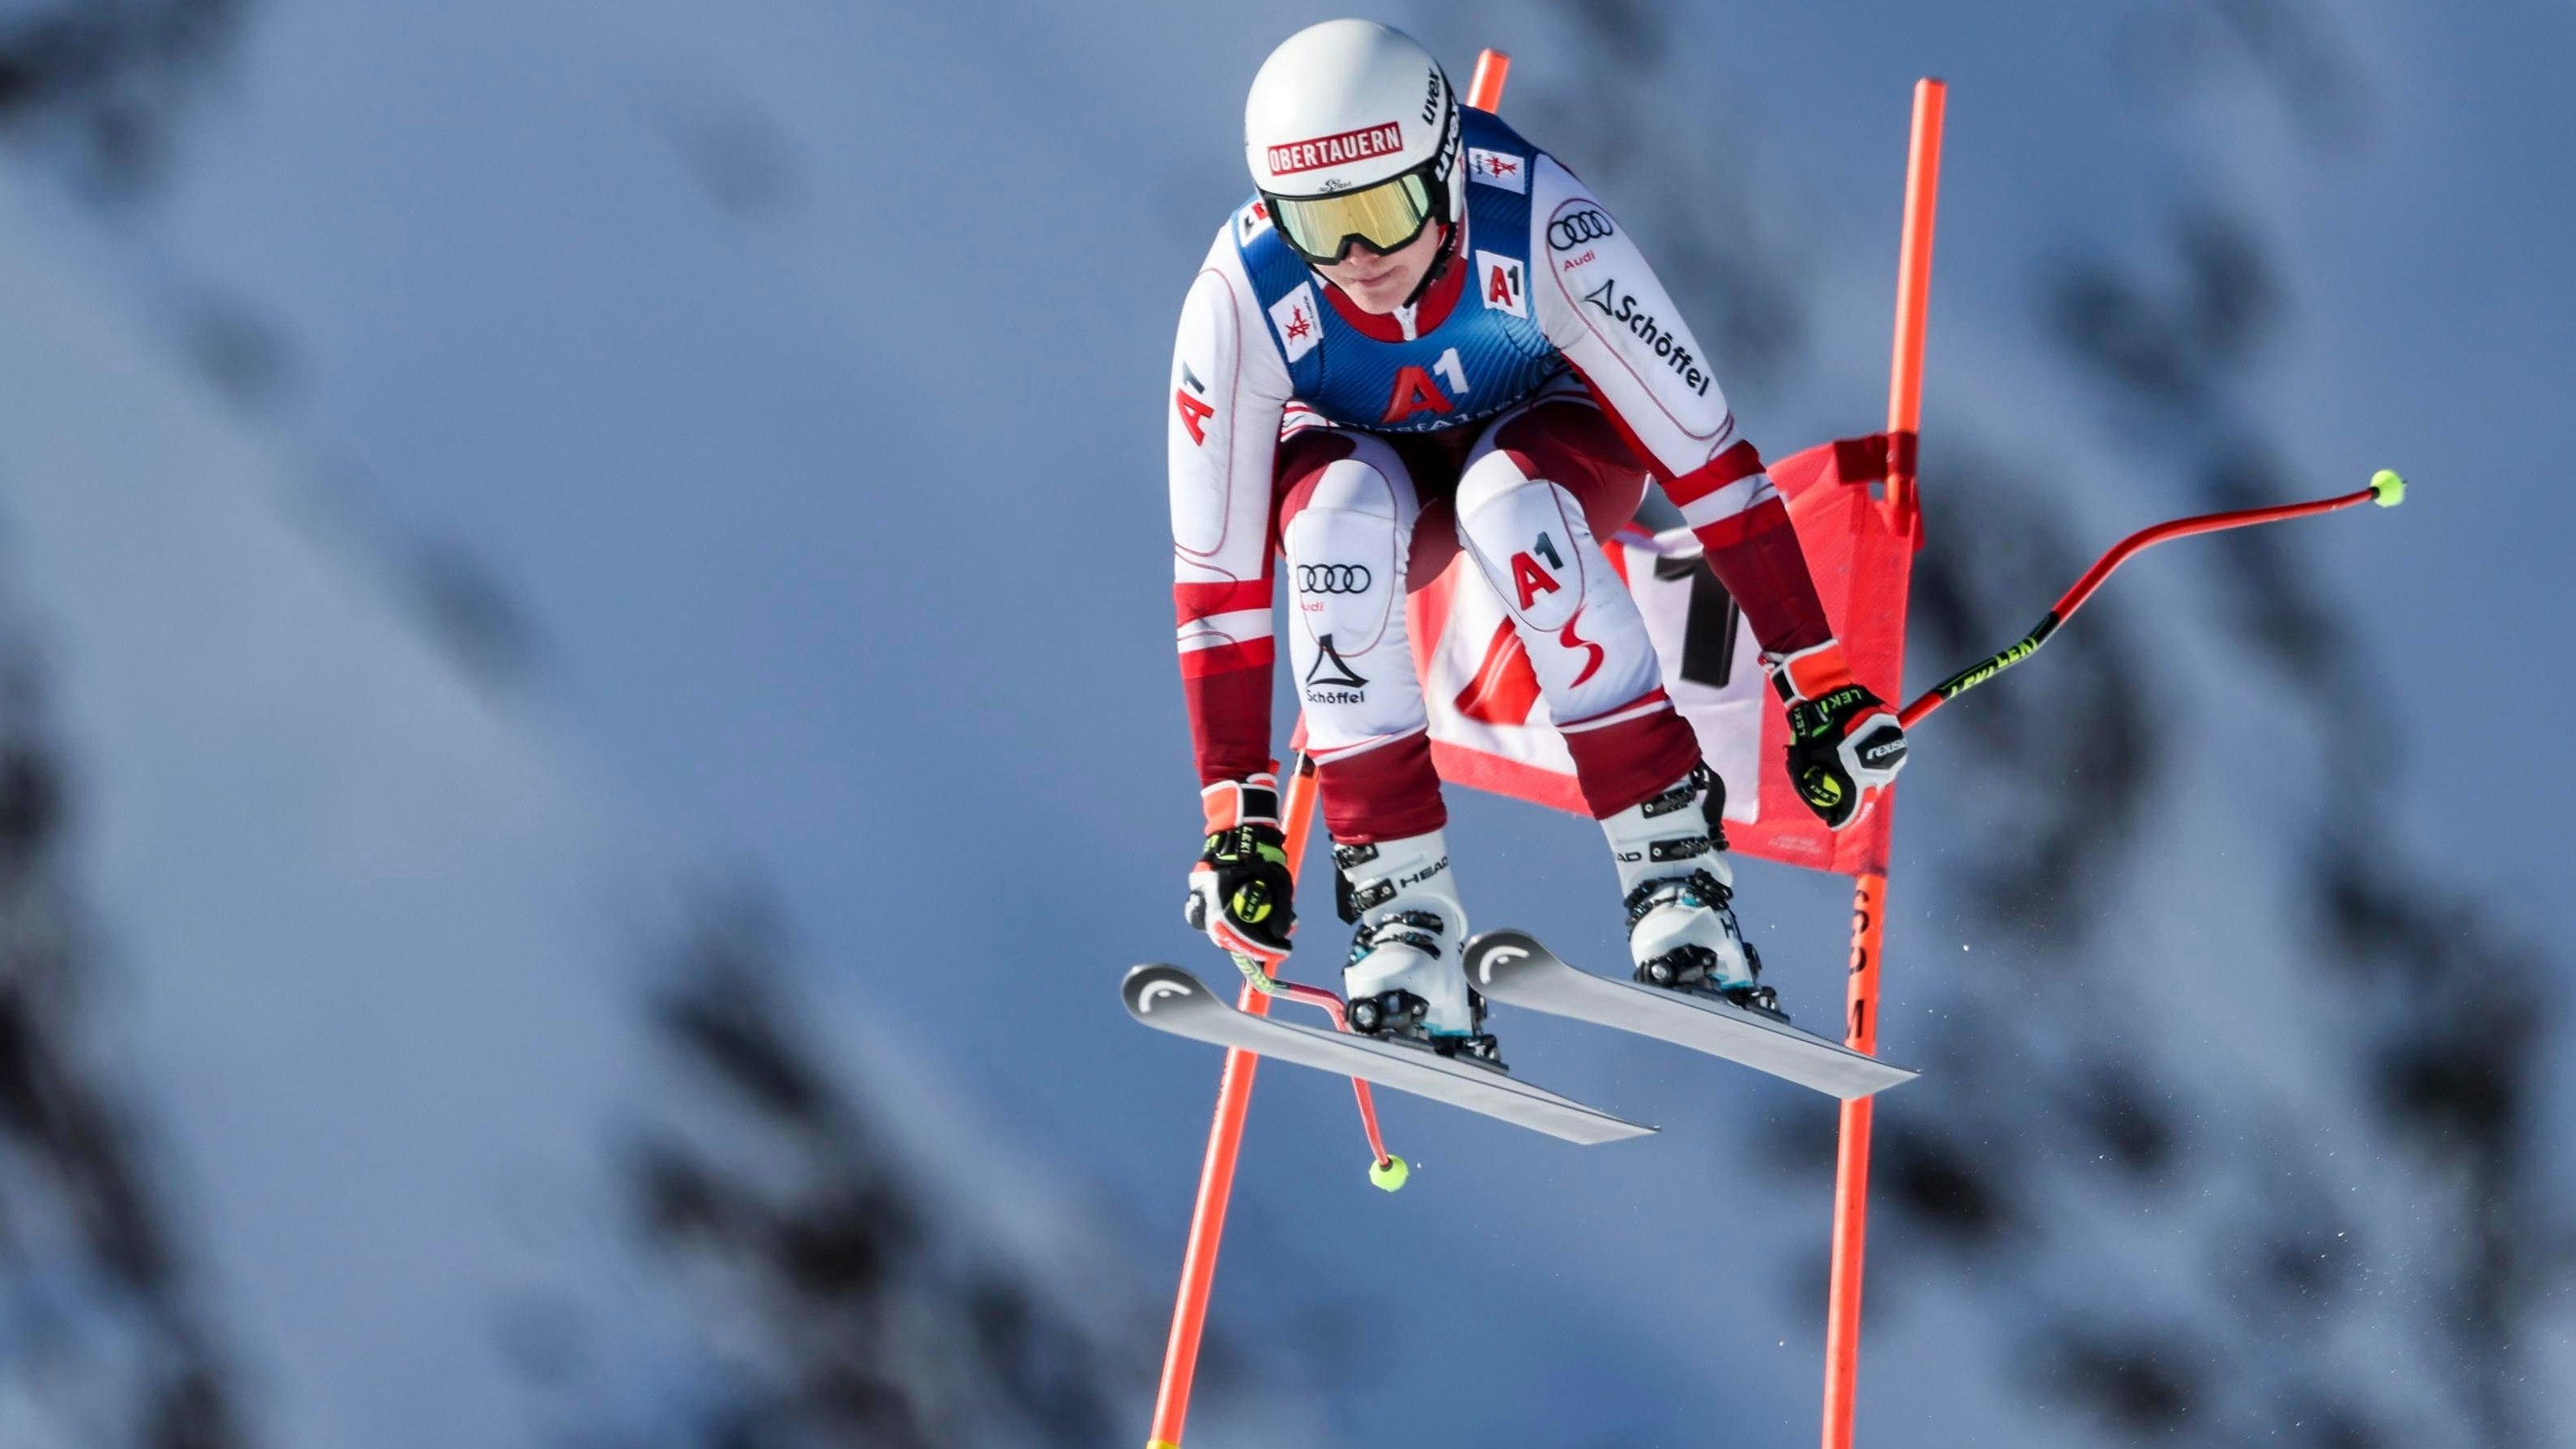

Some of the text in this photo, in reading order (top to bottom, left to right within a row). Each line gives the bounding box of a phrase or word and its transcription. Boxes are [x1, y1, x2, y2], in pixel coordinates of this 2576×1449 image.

[1269, 126, 1401, 172] OBERTAUERN
[1563, 250, 1596, 272] Audi
[1489, 265, 1520, 308] A1
[1614, 295, 1710, 397] Schöffel
[1383, 347, 1470, 423] A1
[1175, 361, 1215, 447] A1
[1510, 531, 1565, 610] A1
[1301, 601, 1324, 612] udi
[1306, 689, 1365, 704] Schöffel
[1821, 688, 1863, 713] LEKI
[1866, 737, 1908, 760] reus
[1240, 826, 1254, 854] LEKI
[1399, 855, 1448, 888] HEAD
[1617, 852, 1643, 864] AD
